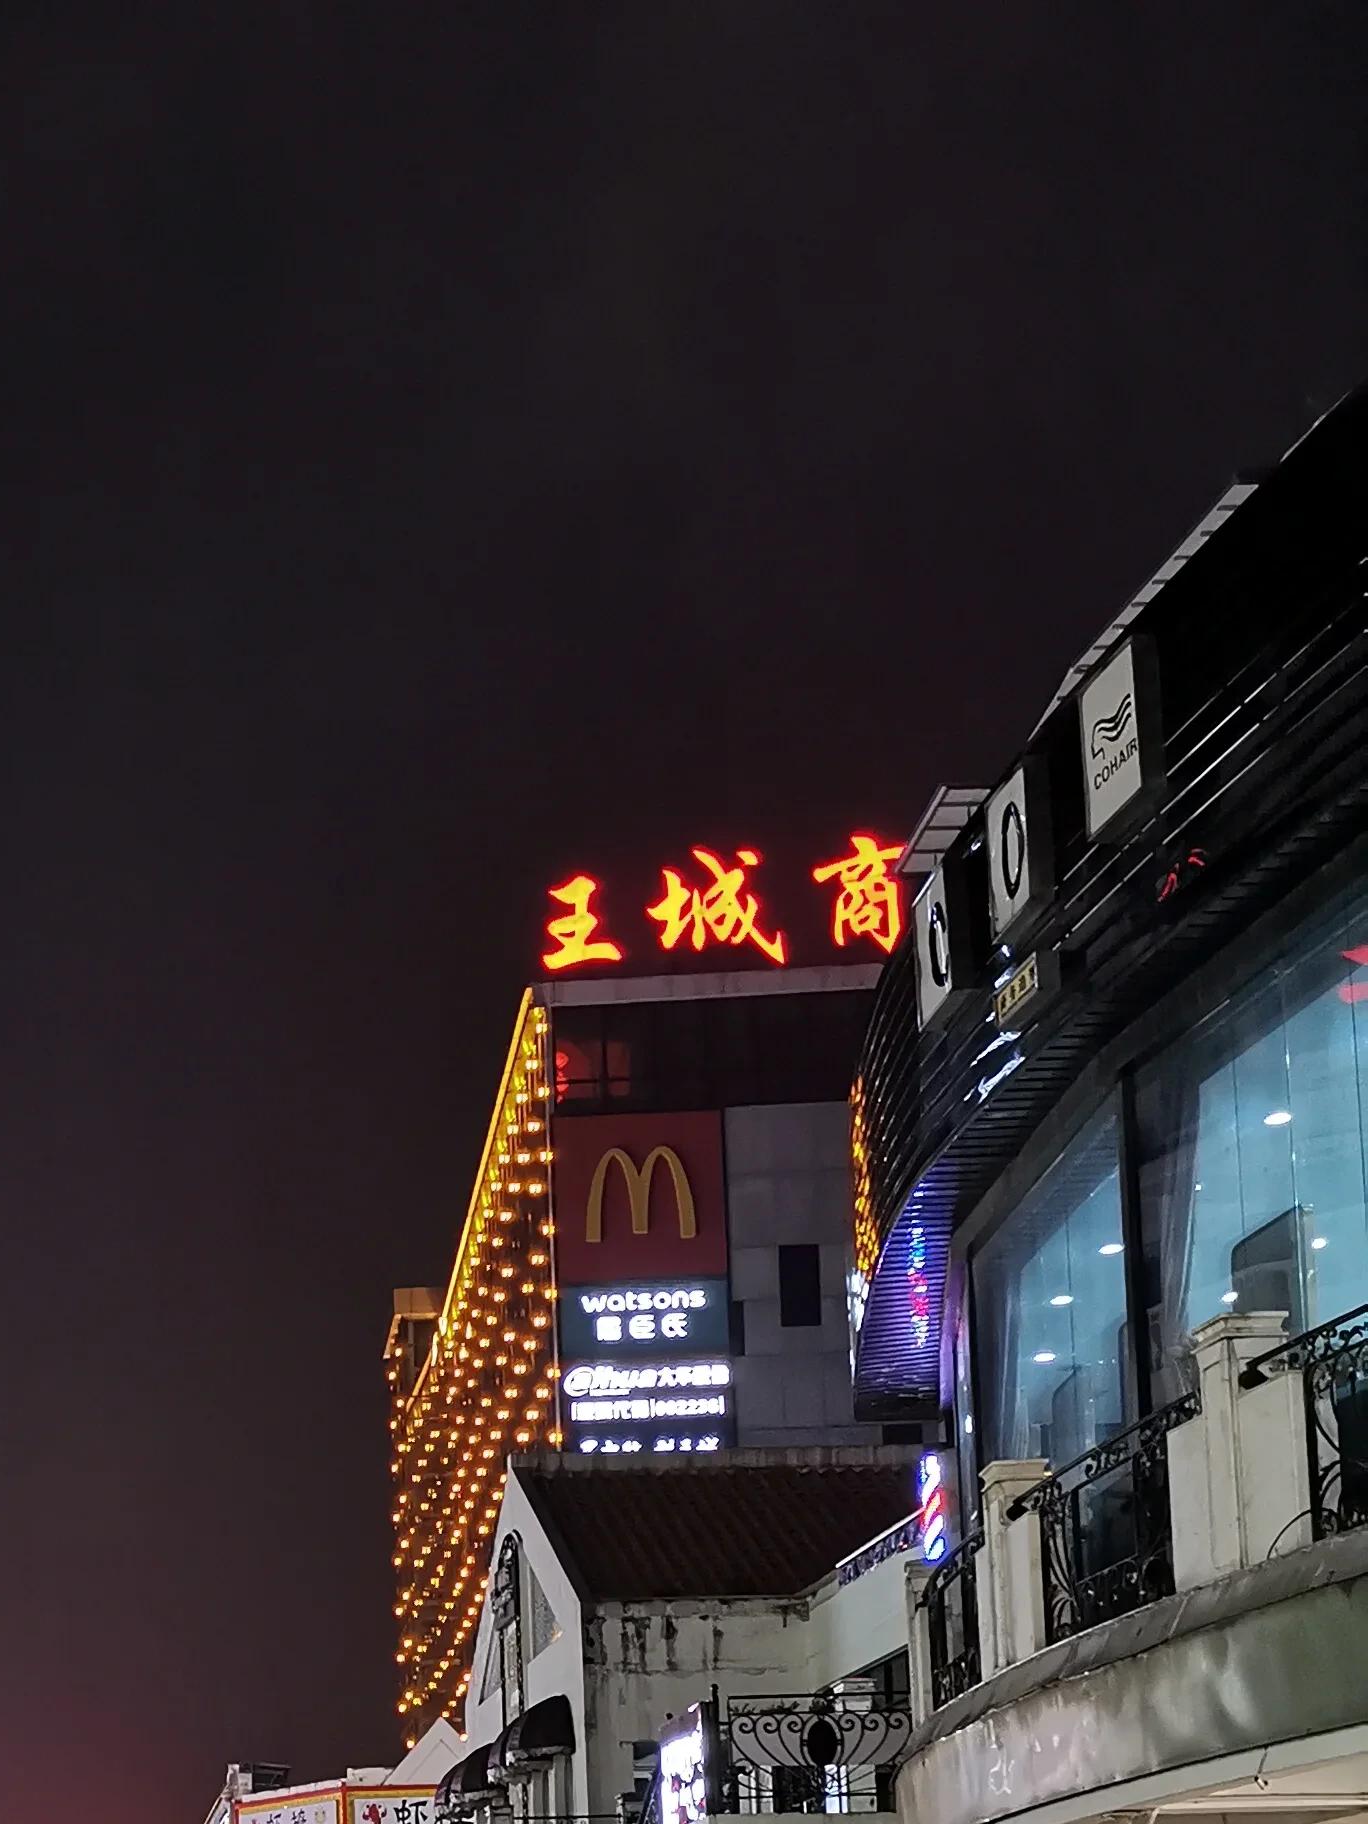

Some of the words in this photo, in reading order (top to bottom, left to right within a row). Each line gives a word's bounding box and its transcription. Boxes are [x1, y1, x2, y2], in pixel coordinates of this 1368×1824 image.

[1094, 736, 1140, 790] COHAIR
[541, 834, 910, 971] 王城商
[580, 1289, 707, 1314] watsons
